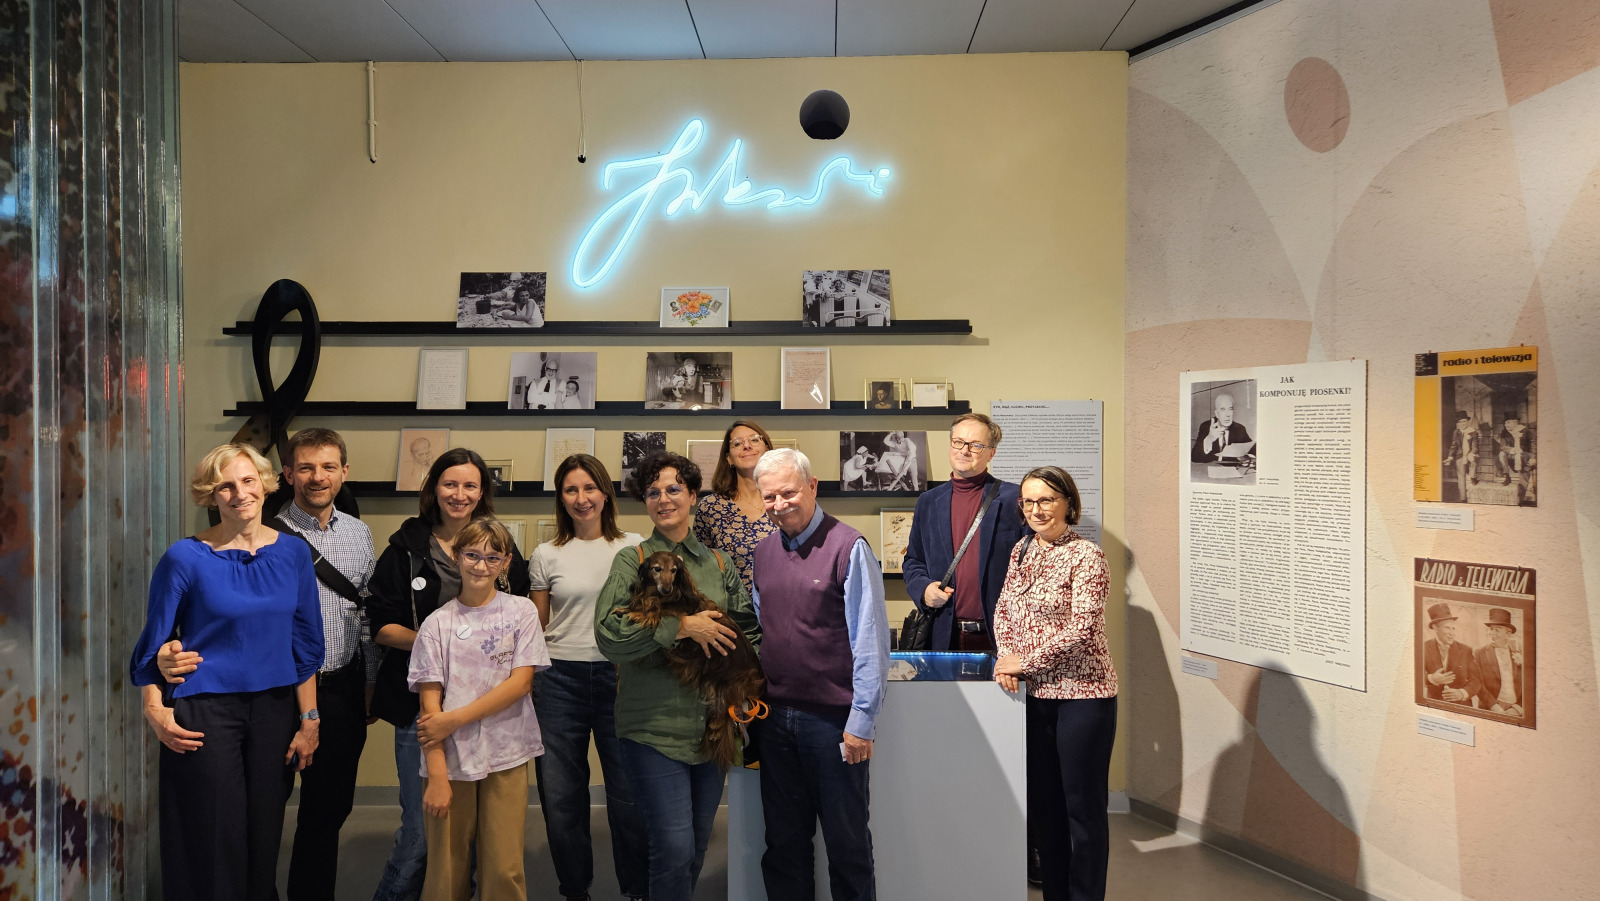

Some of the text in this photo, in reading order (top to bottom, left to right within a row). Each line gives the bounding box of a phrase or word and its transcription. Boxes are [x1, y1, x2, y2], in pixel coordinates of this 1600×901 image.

[1442, 357, 1472, 366] radio
[1481, 353, 1532, 364] telewizja
[1280, 376, 1295, 384] JAK
[1259, 387, 1352, 398] KOMPONUJĘ PIOSENKI?
[1420, 561, 1456, 585] RADIO
[1458, 576, 1464, 586] i
[1465, 565, 1529, 593] TELEWIZJA
